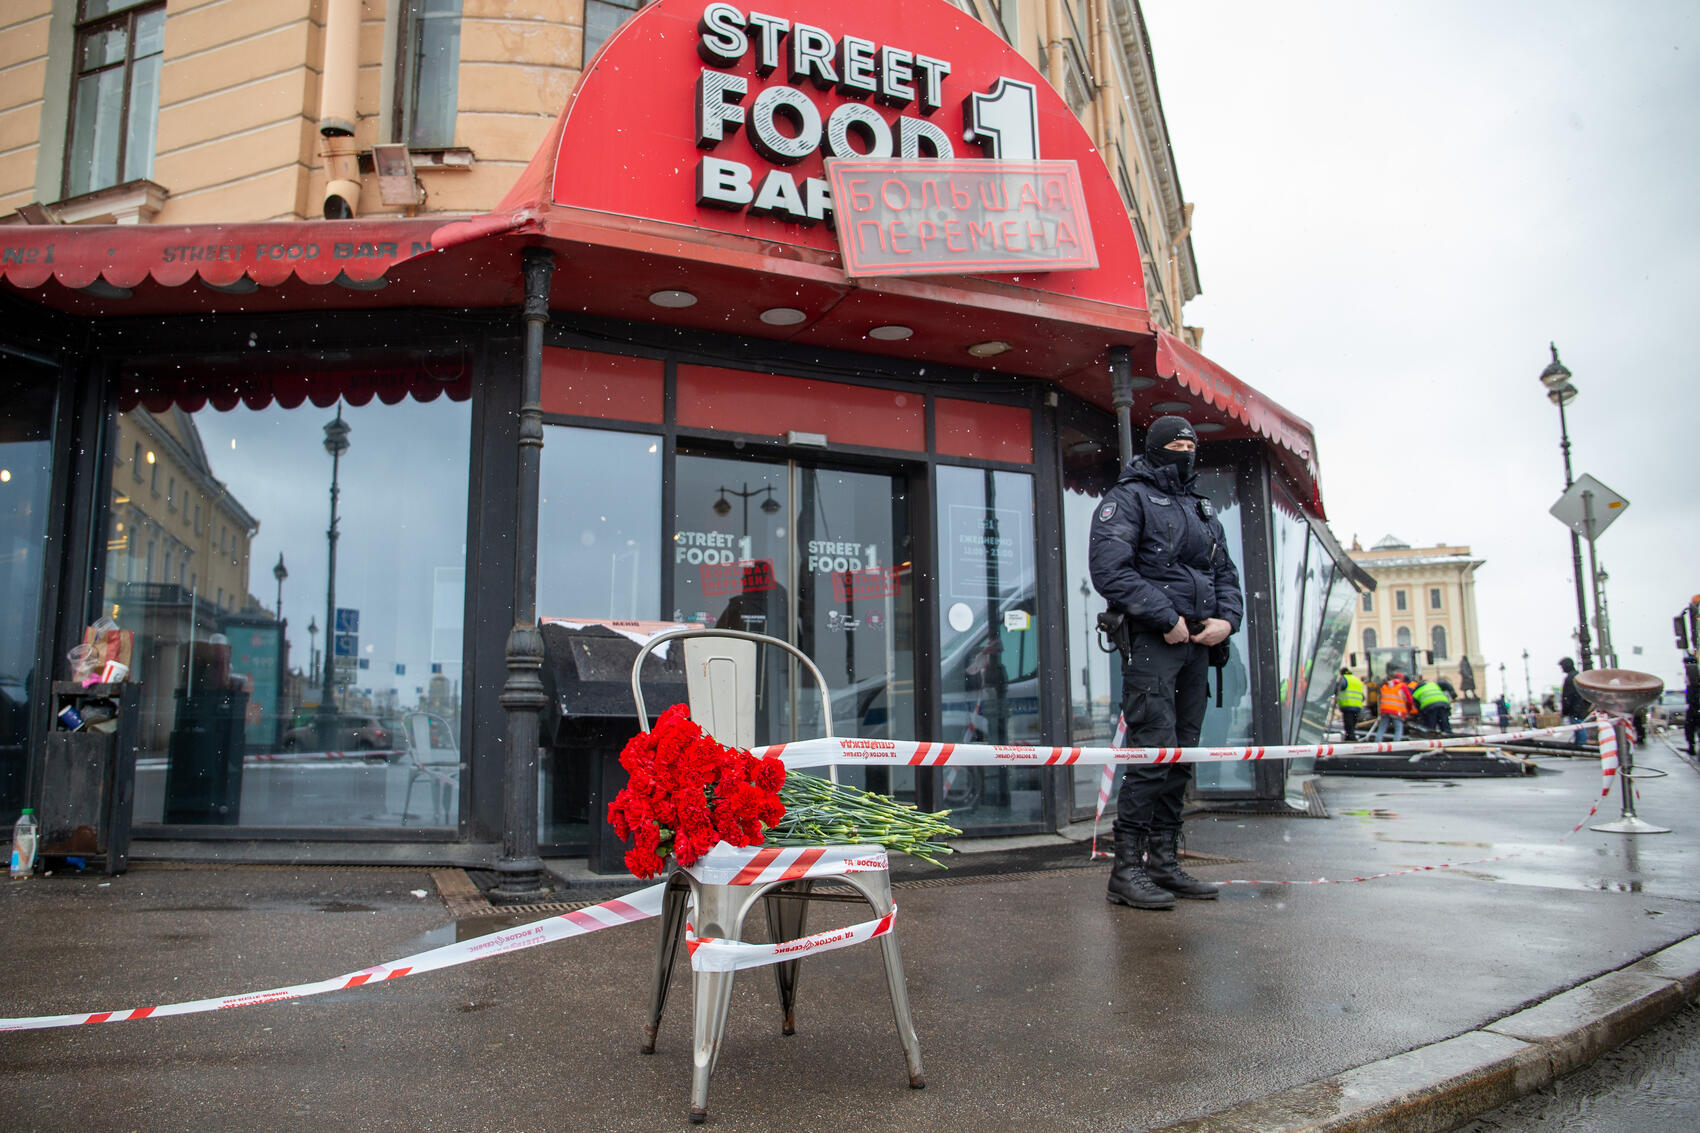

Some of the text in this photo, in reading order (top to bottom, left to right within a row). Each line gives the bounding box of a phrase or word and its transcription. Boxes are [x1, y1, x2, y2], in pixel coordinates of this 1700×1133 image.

[699, 2, 951, 112] STREET
[699, 69, 955, 159] FOOD
[849, 179, 1073, 213] БОЛЬШАЯ
[162, 244, 245, 263] STREET
[256, 243, 321, 261] FOOD
[333, 242, 399, 259] BAR
[857, 220, 1079, 254] ПЕРЕМЕНА
[675, 535, 755, 568] FOOD 1
[676, 531, 735, 548] STREET
[808, 541, 861, 556] STREET
[808, 543, 880, 575] FOOD 1
